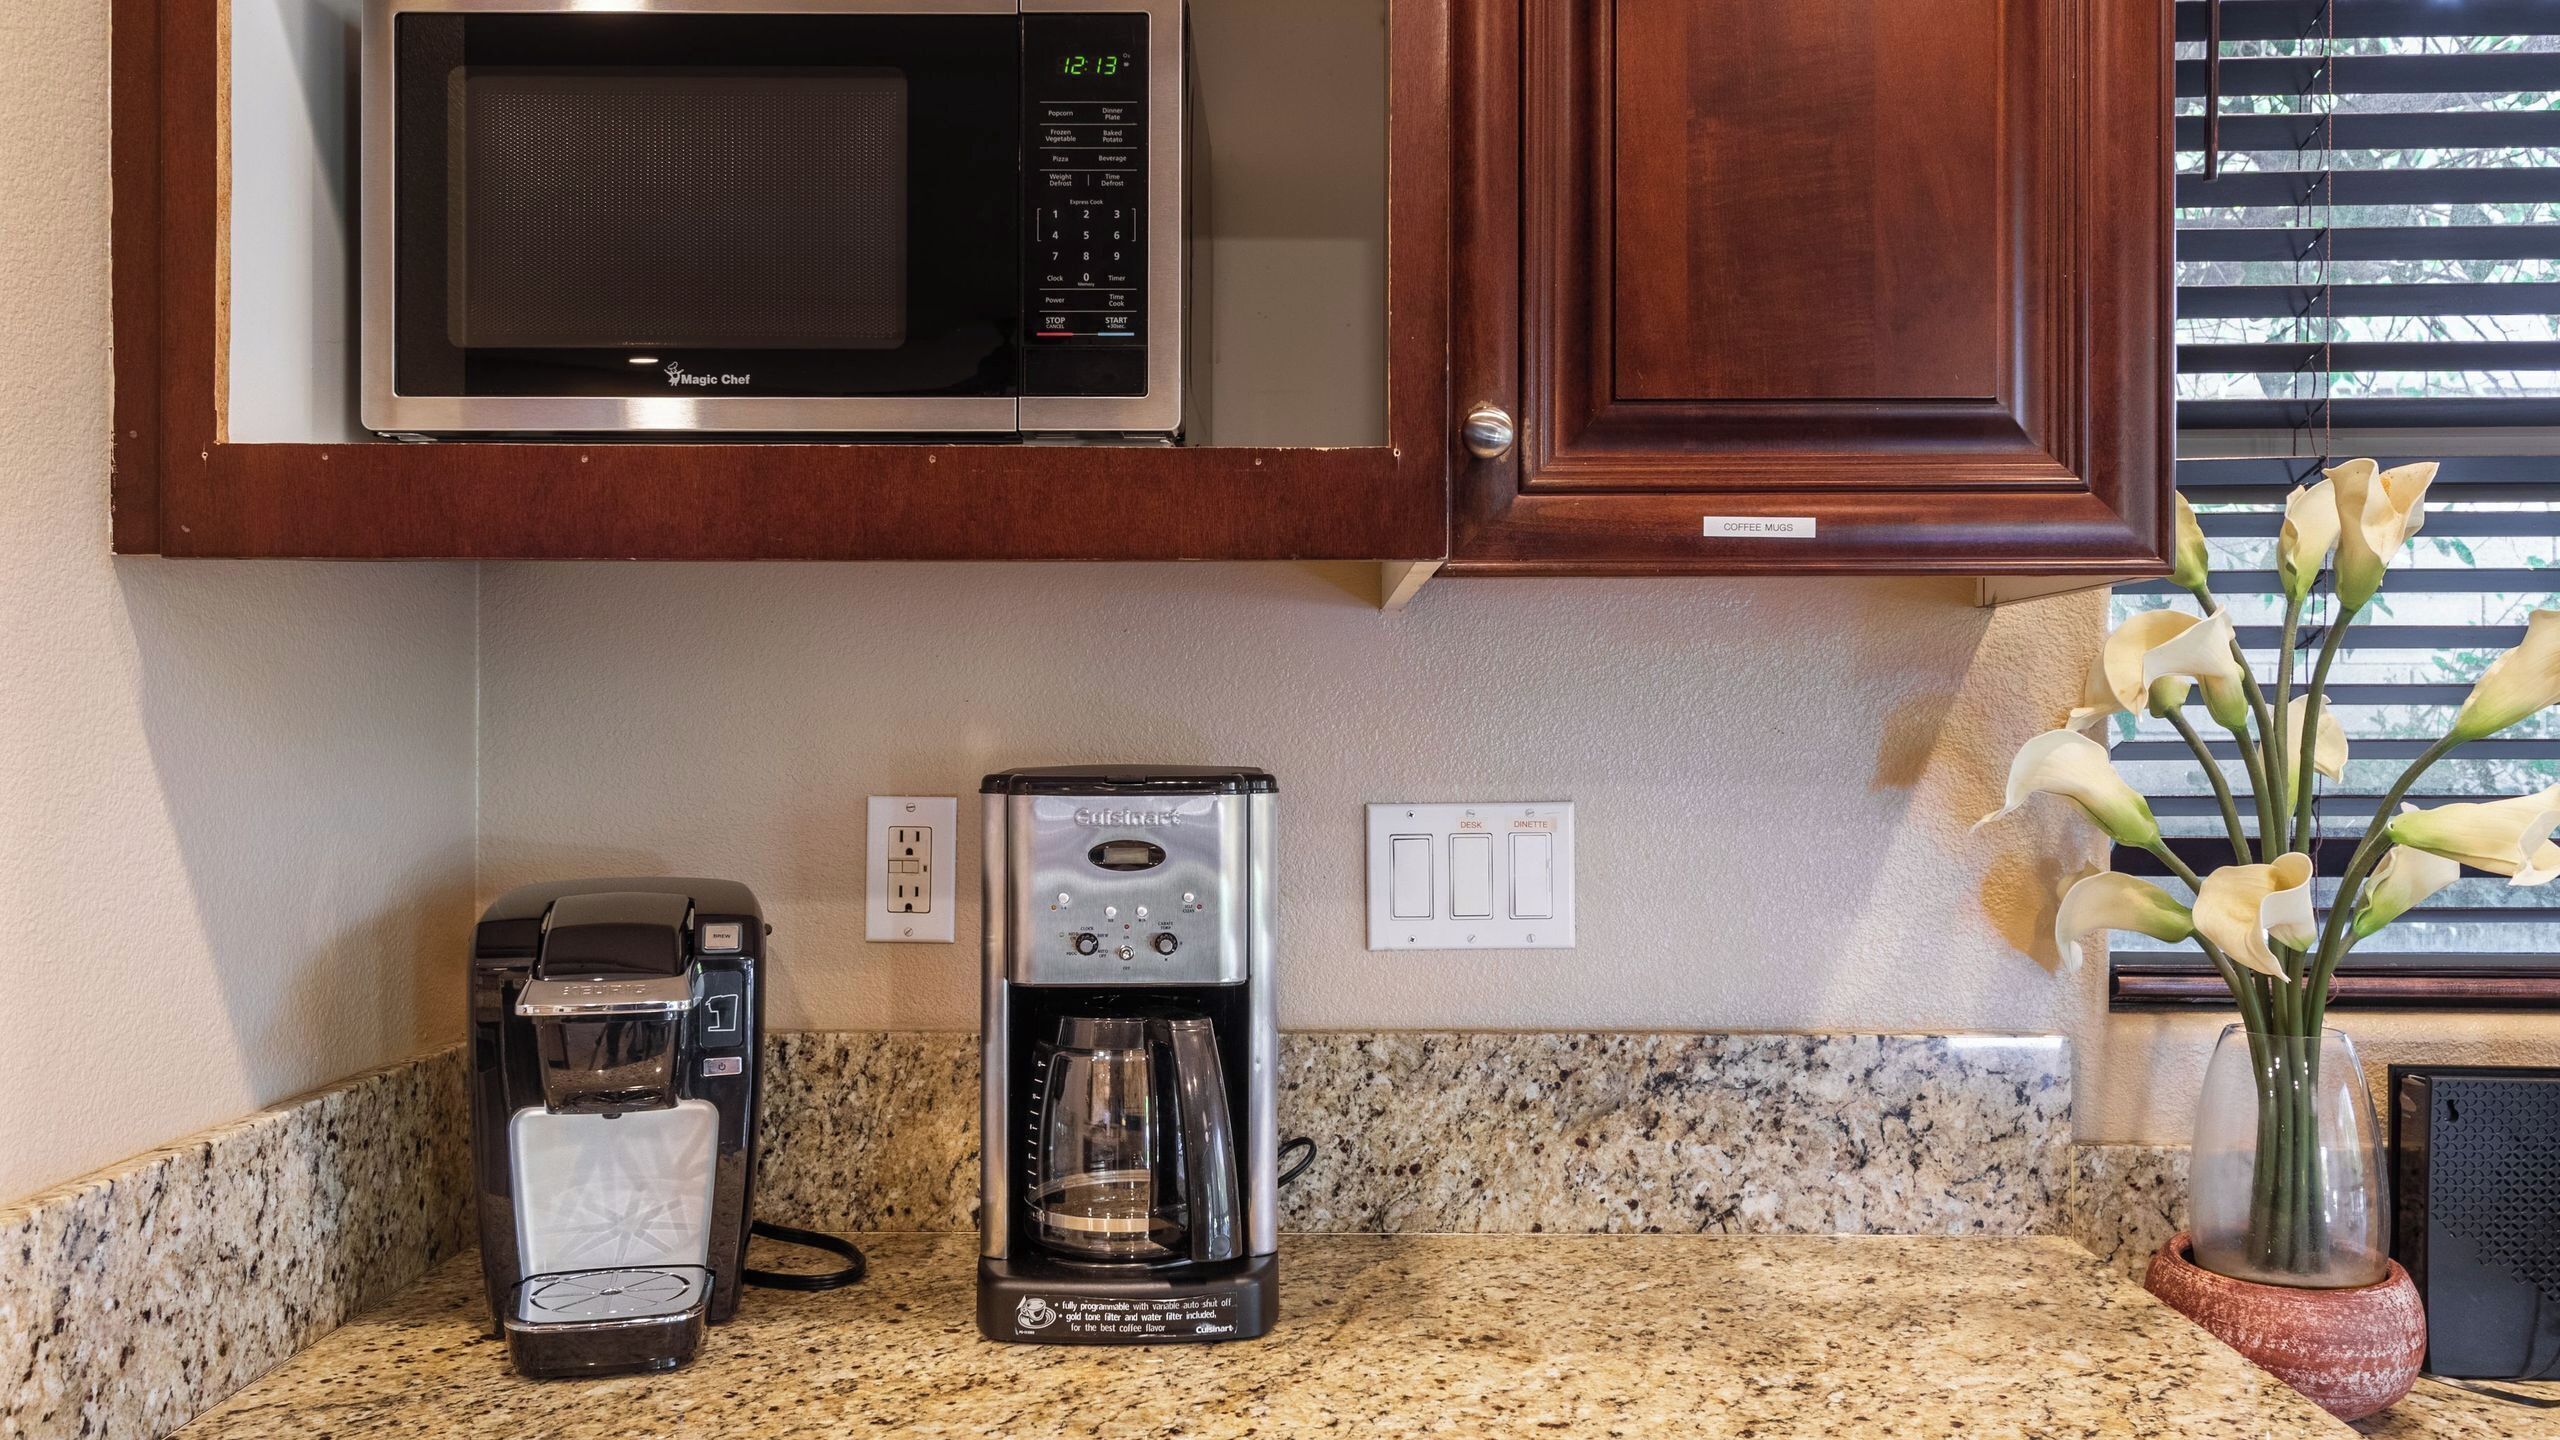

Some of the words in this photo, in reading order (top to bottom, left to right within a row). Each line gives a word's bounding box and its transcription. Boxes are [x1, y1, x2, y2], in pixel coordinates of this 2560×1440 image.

[1064, 56, 1117, 75] 12:13
[1053, 210, 1058, 219] 1
[1083, 210, 1090, 219] 2
[1113, 210, 1120, 219] 3
[1052, 231, 1059, 240] 4
[1083, 231, 1090, 240] 5
[1113, 231, 1120, 240] 6
[1052, 252, 1059, 261] 7
[1083, 252, 1090, 261] 8
[1113, 252, 1120, 261] 9
[1083, 273, 1090, 282] 0
[681, 374, 718, 386] Magic
[721, 374, 750, 384] Chef
[1723, 522, 1761, 532] COFFEE
[1764, 523, 1794, 532] MUGS
[1074, 807, 1181, 827] Cuisinart
[1460, 821, 1482, 829] DESK
[1513, 820, 1548, 828] DINETTE
[1062, 1300, 1078, 1312] fully
[1080, 1301, 1130, 1312] programmable
[1133, 1302, 1149, 1311] with
[1152, 1301, 1180, 1311] variable
[1183, 1300, 1199, 1309] auto
[1202, 1298, 1218, 1308] shut
[1221, 1298, 1231, 1307] off
[1065, 1312, 1081, 1323] gold
[1085, 1312, 1101, 1321] tone
[1104, 1312, 1121, 1321] filter
[1124, 1313, 1138, 1321] and
[1141, 1313, 1162, 1322] water
[1165, 1311, 1183, 1320] filter
[1070, 1322, 1081, 1332] for
[1084, 1323, 1097, 1332] the
[1100, 1323, 1116, 1332] best
[1119, 1323, 1142, 1333] coffee
[1145, 1322, 1166, 1332] flavor
[1195, 1323, 1234, 1335] Cuisinart
